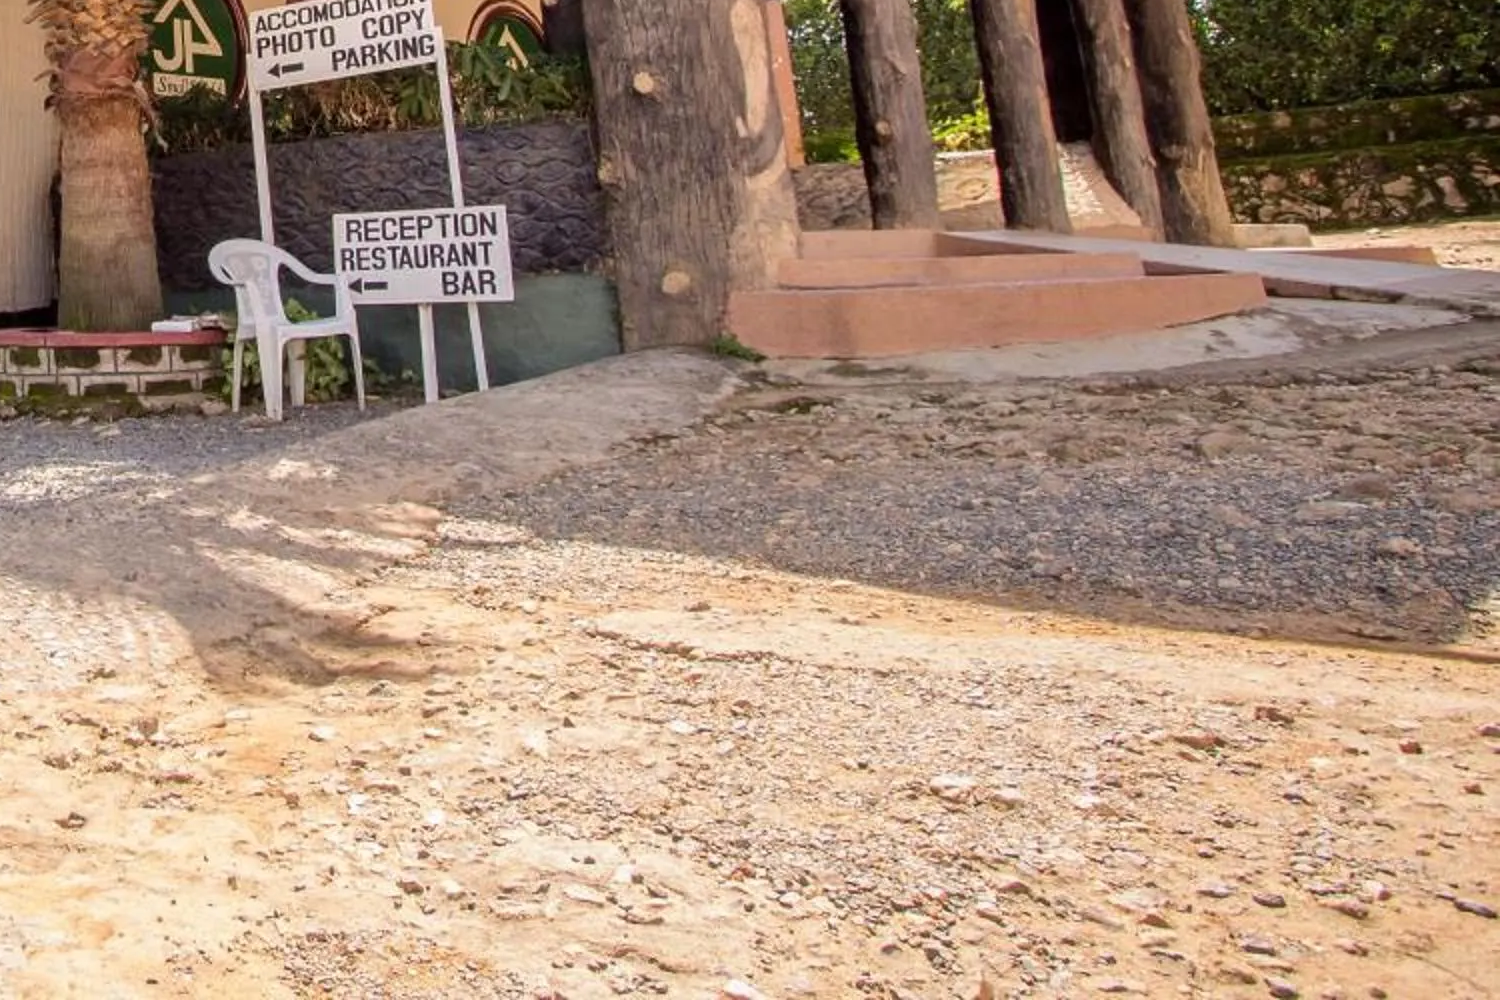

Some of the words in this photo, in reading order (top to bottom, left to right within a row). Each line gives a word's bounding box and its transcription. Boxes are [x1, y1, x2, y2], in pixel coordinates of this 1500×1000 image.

[256, 25, 336, 58] PHOTO
[361, 8, 426, 39] COPY
[331, 34, 436, 71] PARKING
[346, 212, 498, 242] RECEPTION
[341, 242, 493, 271] RESTAURANT
[441, 269, 497, 296] BAR
